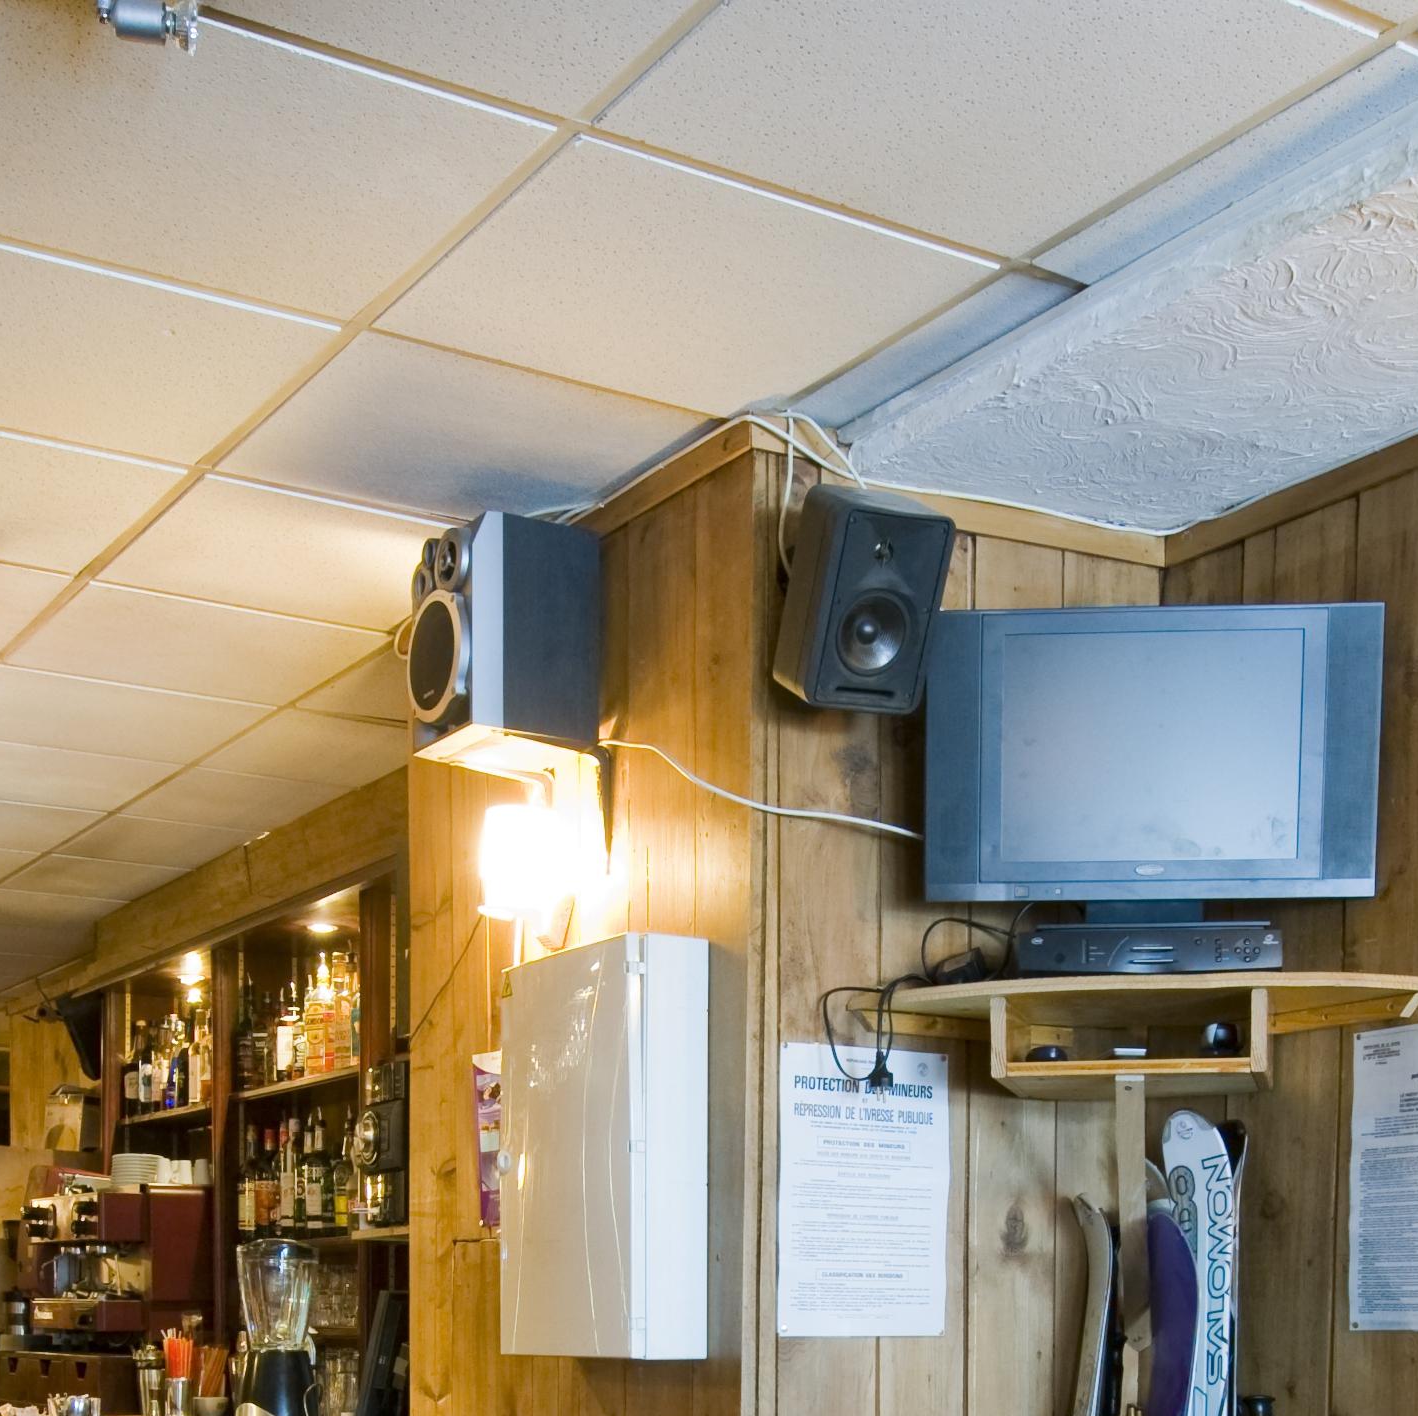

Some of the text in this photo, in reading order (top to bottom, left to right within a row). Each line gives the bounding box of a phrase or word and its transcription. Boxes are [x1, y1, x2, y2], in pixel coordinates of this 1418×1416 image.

[794, 1075, 860, 1094] PROTECTION
[888, 1083, 933, 1099] MINEURS
[794, 1102, 933, 1125] RÉPRESSION DE L'IVRESSE PUBLIQUE
[1201, 1153, 1233, 1386] SALOMON
